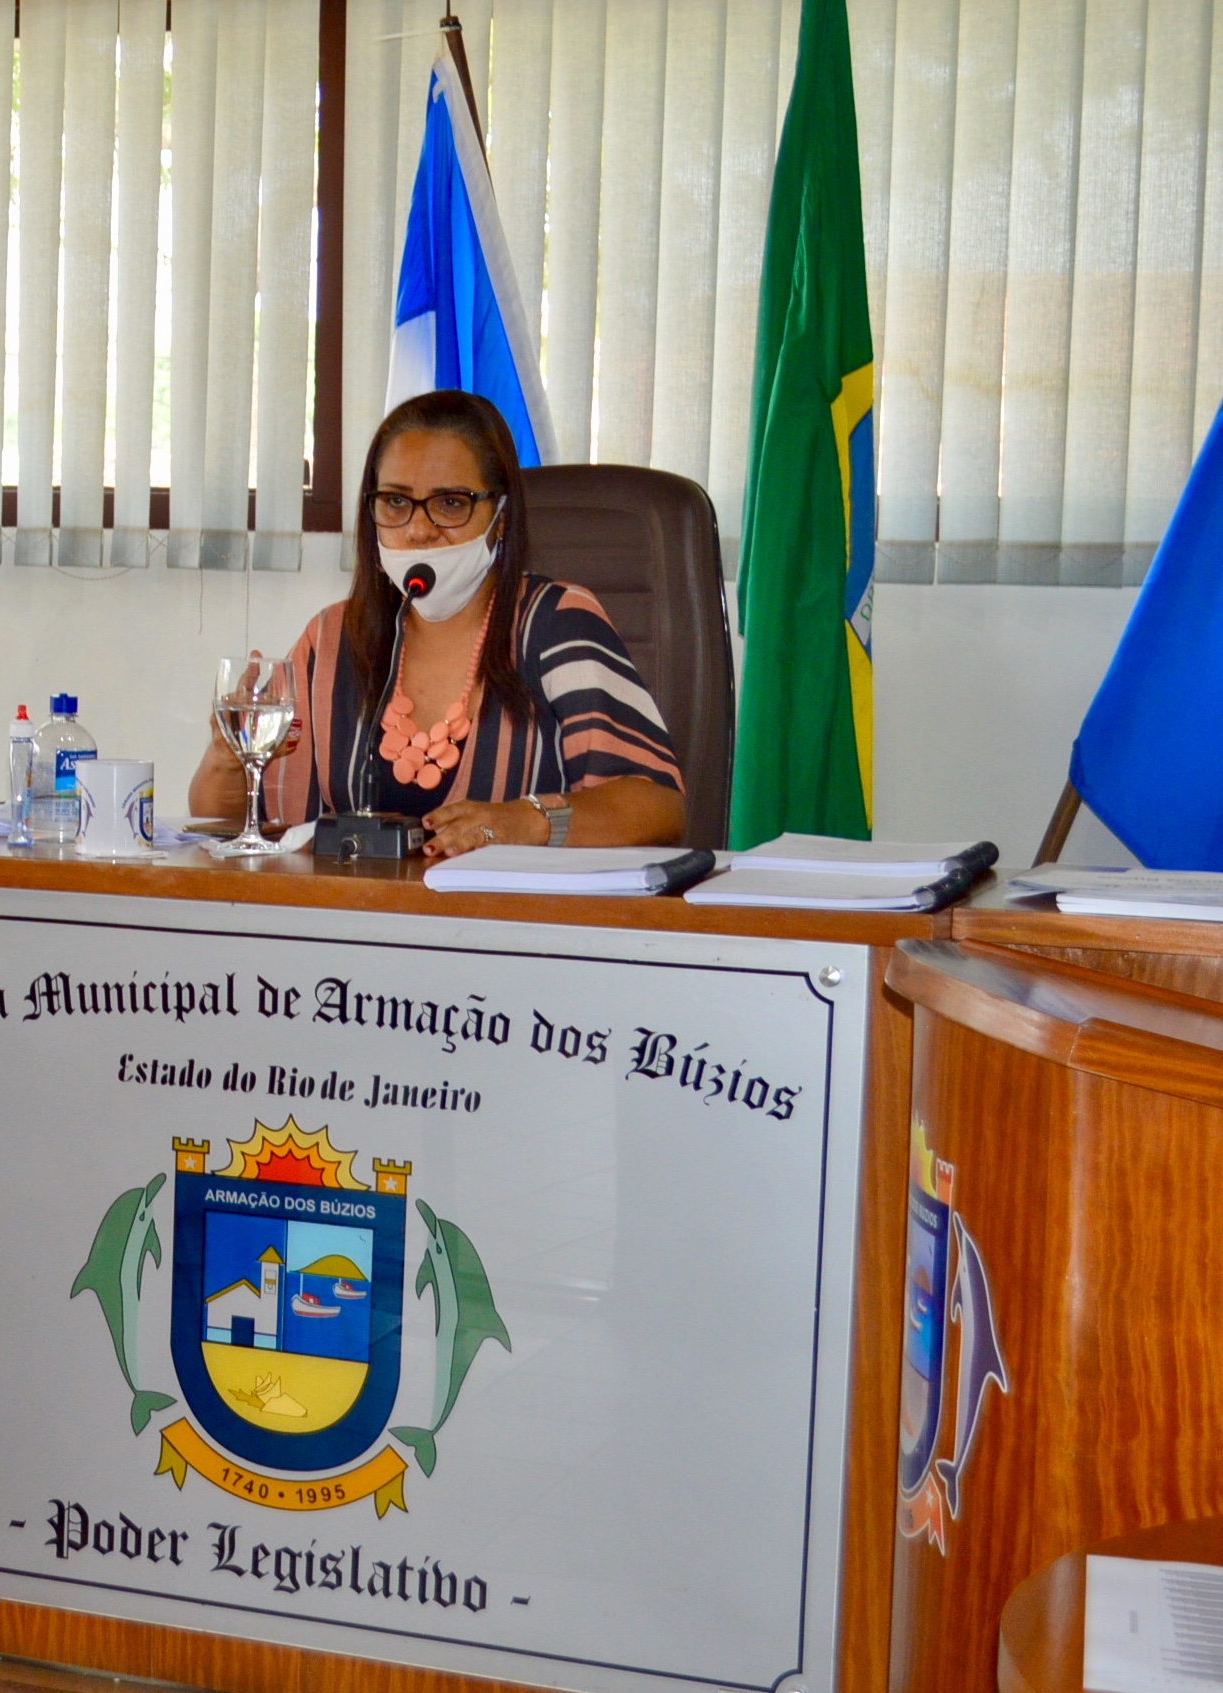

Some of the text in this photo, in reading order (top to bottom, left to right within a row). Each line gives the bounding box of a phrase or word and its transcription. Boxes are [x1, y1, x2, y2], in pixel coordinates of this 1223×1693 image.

[22, 970, 240, 1024] Municipal
[256, 974, 302, 1020] de
[312, 977, 511, 1054] Armação
[530, 1008, 613, 1065] dos
[625, 1026, 803, 1121] Búzios
[117, 1053, 481, 1113] Estado do Rio de Janeiro
[204, 1188, 376, 1220] ARMAÇÃO DOS BÚZIOS
[222, 1467, 346, 1504] 1740 1995
[45, 1498, 190, 1567] Poder
[206, 1521, 488, 1613] Legislativo
